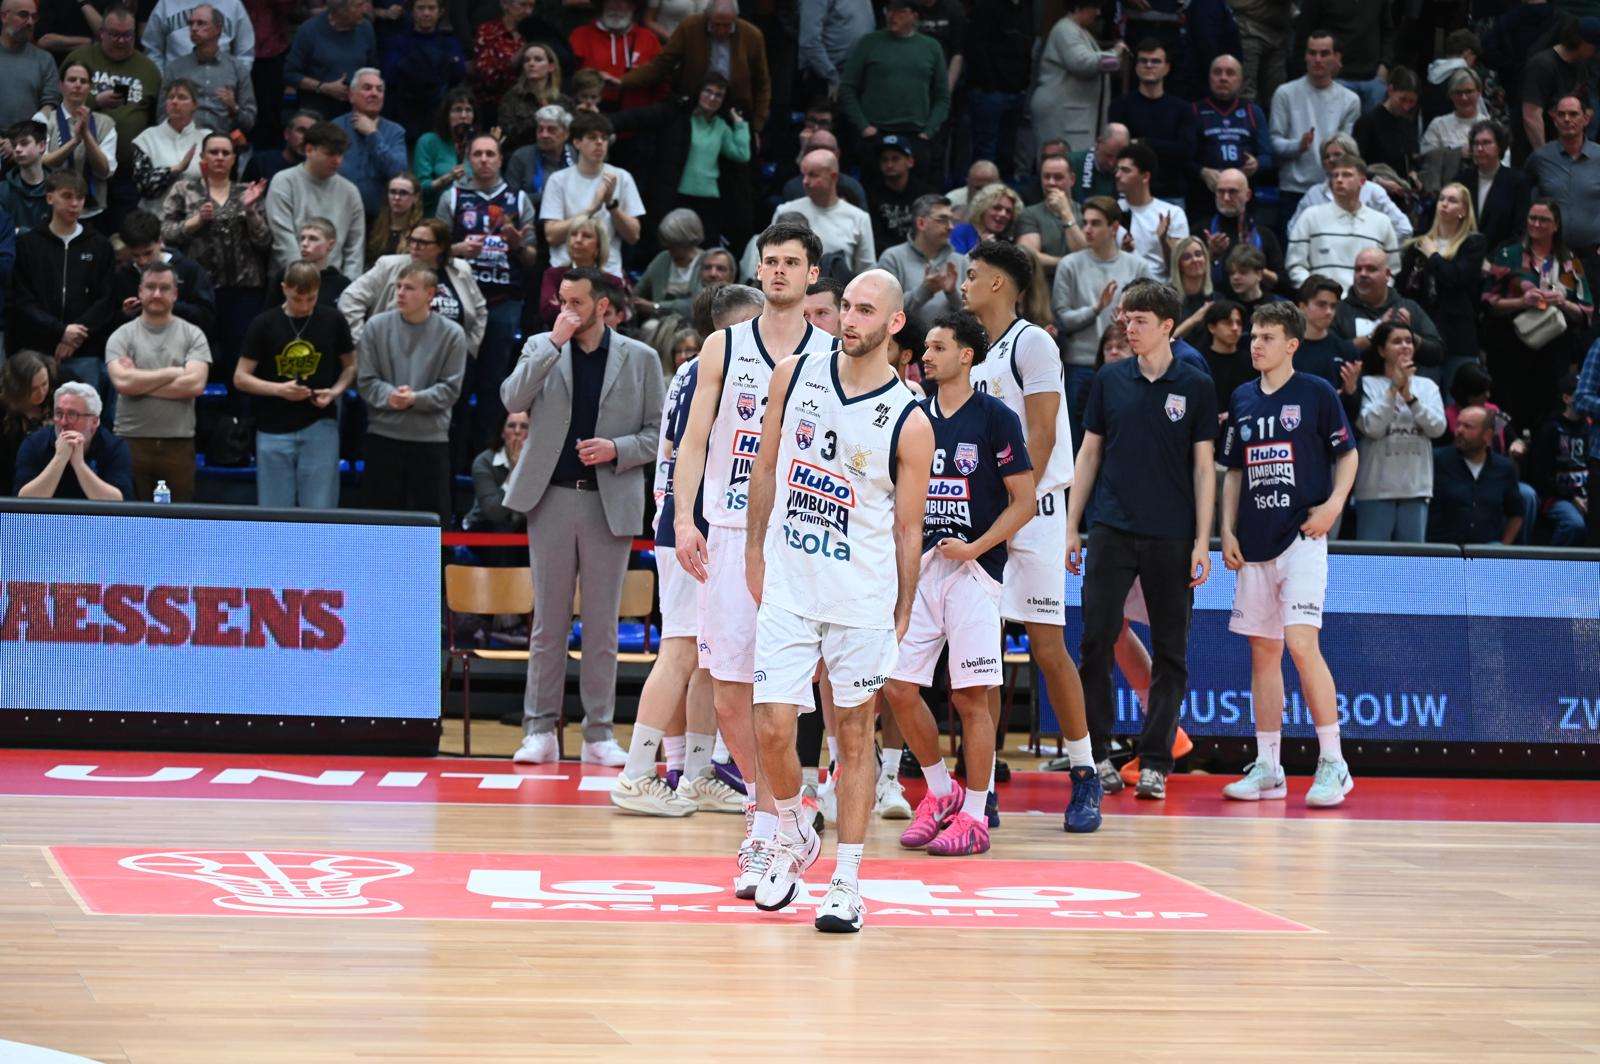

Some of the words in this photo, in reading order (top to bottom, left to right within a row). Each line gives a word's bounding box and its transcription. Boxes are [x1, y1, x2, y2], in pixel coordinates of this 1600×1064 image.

[1221, 144, 1238, 161] 16
[805, 381, 826, 392] CRAFT
[1257, 416, 1275, 440] 11
[820, 430, 837, 461] 3
[1250, 447, 1289, 461] Hubo
[932, 448, 947, 475] 6
[792, 465, 850, 499] Hubo
[928, 481, 963, 496] ubo
[1254, 490, 1290, 510] isola
[800, 512, 830, 528] UNITED
[926, 516, 951, 525] UNITED
[783, 521, 851, 561] isola
[0, 581, 345, 650] AESSENS
[862, 674, 888, 688] bailli
[491, 901, 1018, 918] BASKETALL
[1050, 910, 1209, 919] CUP
